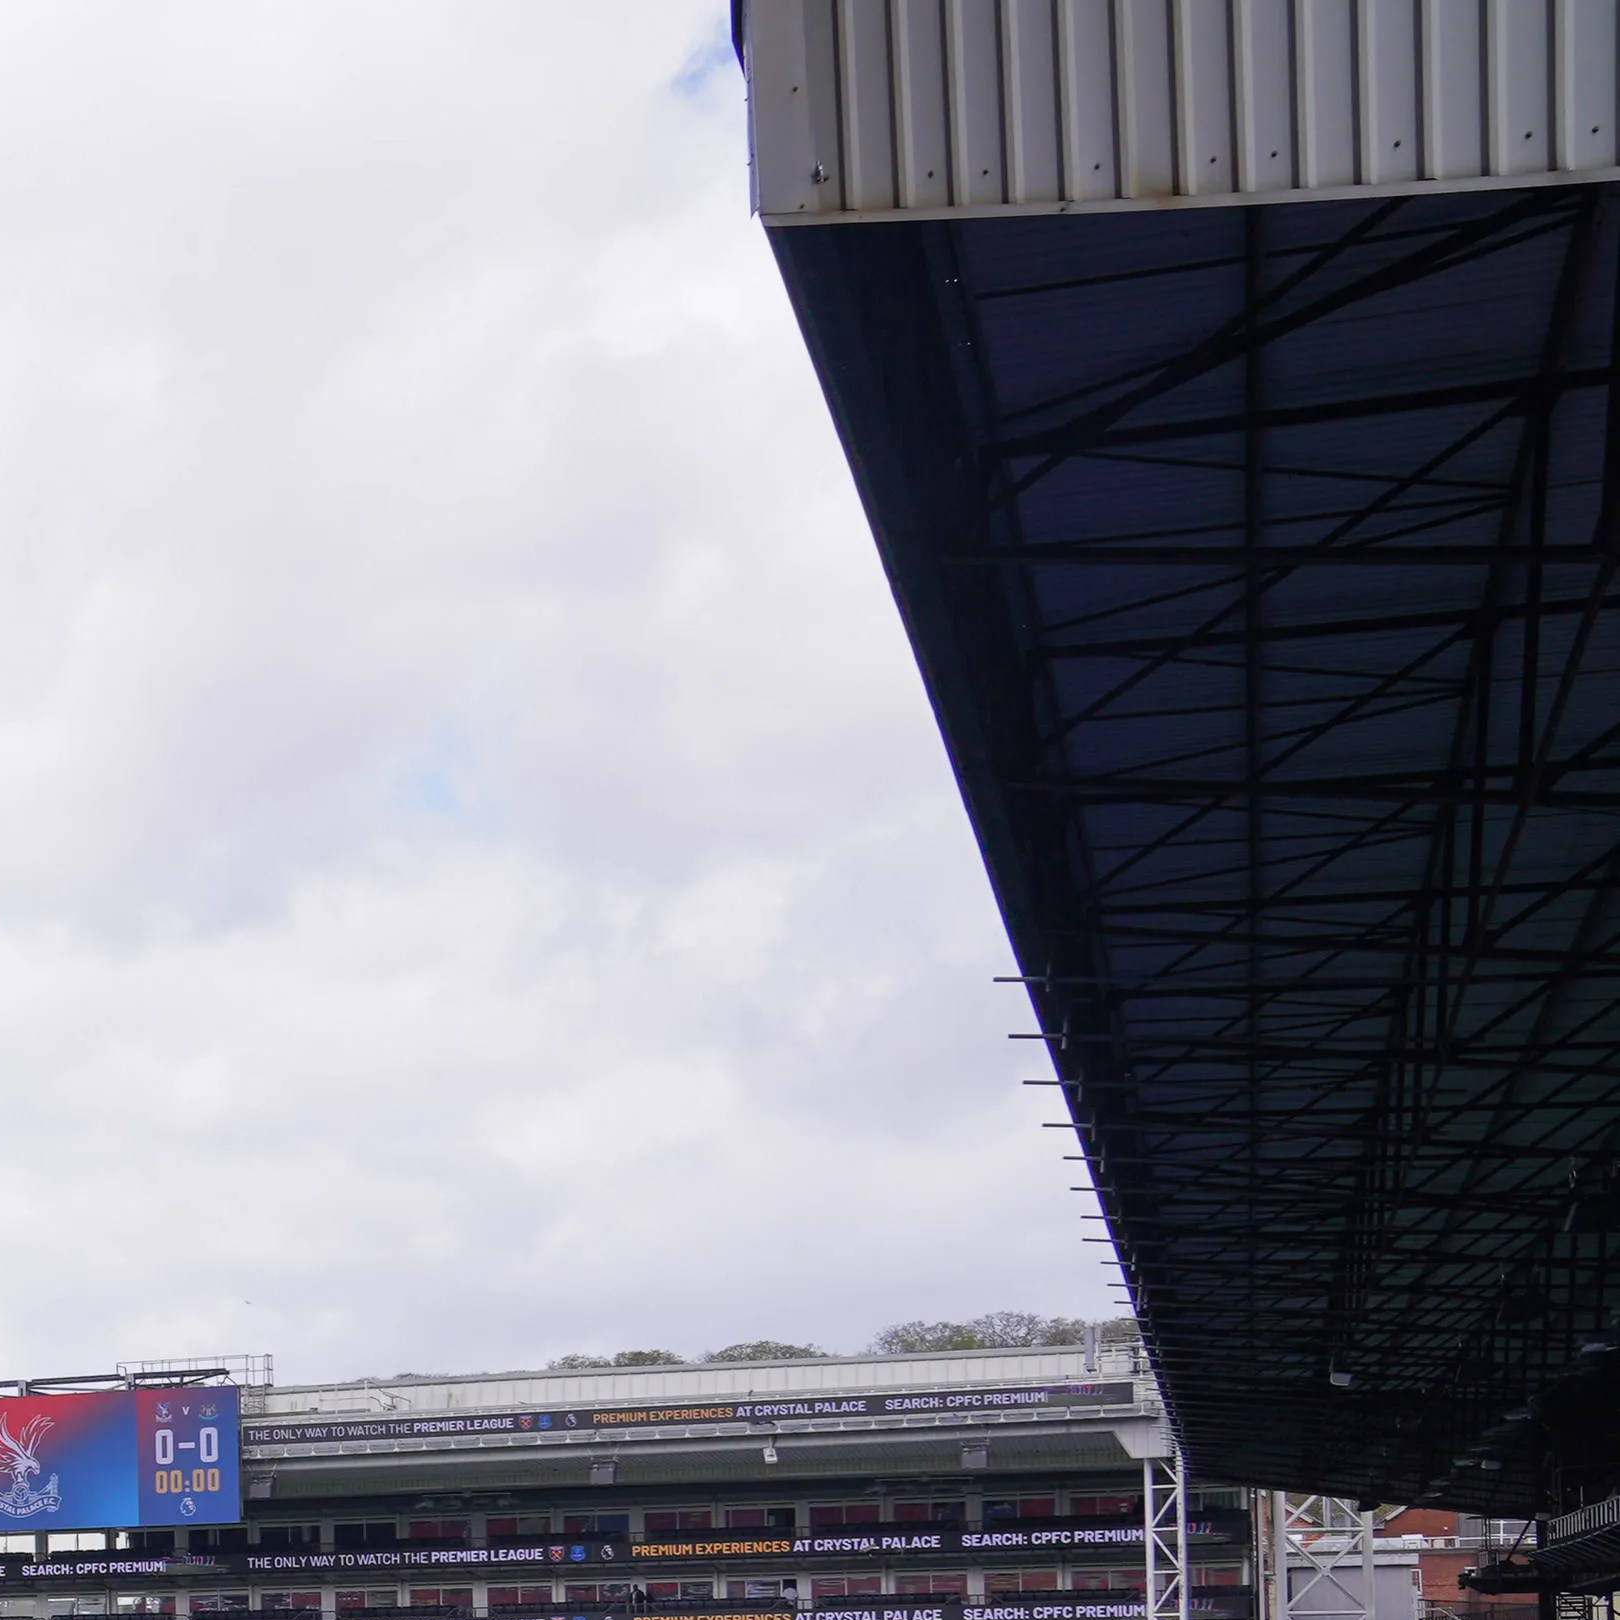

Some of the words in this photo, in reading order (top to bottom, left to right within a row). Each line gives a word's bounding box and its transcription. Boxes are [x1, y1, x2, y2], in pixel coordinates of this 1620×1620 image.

[884, 1397, 942, 1410] SEARCH:
[946, 1395, 981, 1407] CPFC
[984, 1392, 1044, 1405] PREMIUM
[593, 1411, 646, 1423] PREMIUM
[650, 1407, 732, 1421] EXPERIENCES
[736, 1406, 752, 1417] AT
[754, 1403, 812, 1416] CRYSTAL
[814, 1401, 866, 1413] PALACE
[249, 1430, 269, 1440] THE
[273, 1428, 304, 1439] ONLY
[305, 1427, 327, 1438] WAY
[330, 1426, 344, 1437] TO
[346, 1424, 385, 1436] WATCH
[388, 1423, 410, 1434] THE
[413, 1421, 463, 1433] PREMIER
[467, 1418, 513, 1430] LEAGUE
[155, 1427, 219, 1465] 0-0
[155, 1469, 220, 1493] 00:00
[16, 1501, 42, 1515] PALACE
[961, 1533, 1027, 1546] SEARCH:
[1031, 1532, 1071, 1544] CPFC
[1074, 1530, 1143, 1543] PREMIUM
[632, 1544, 692, 1556] PREMIUM
[695, 1541, 789, 1554] EXPERIENCES
[793, 1540, 811, 1551] AT
[248, 1556, 270, 1568] THE
[274, 1555, 307, 1567] ONLY
[310, 1555, 335, 1566] WAY
[338, 1554, 353, 1565] TO
[356, 1553, 399, 1565] WATCH
[403, 1552, 428, 1564] THE
[431, 1551, 487, 1563] PREMIER
[490, 1549, 542, 1561] LEAGUE
